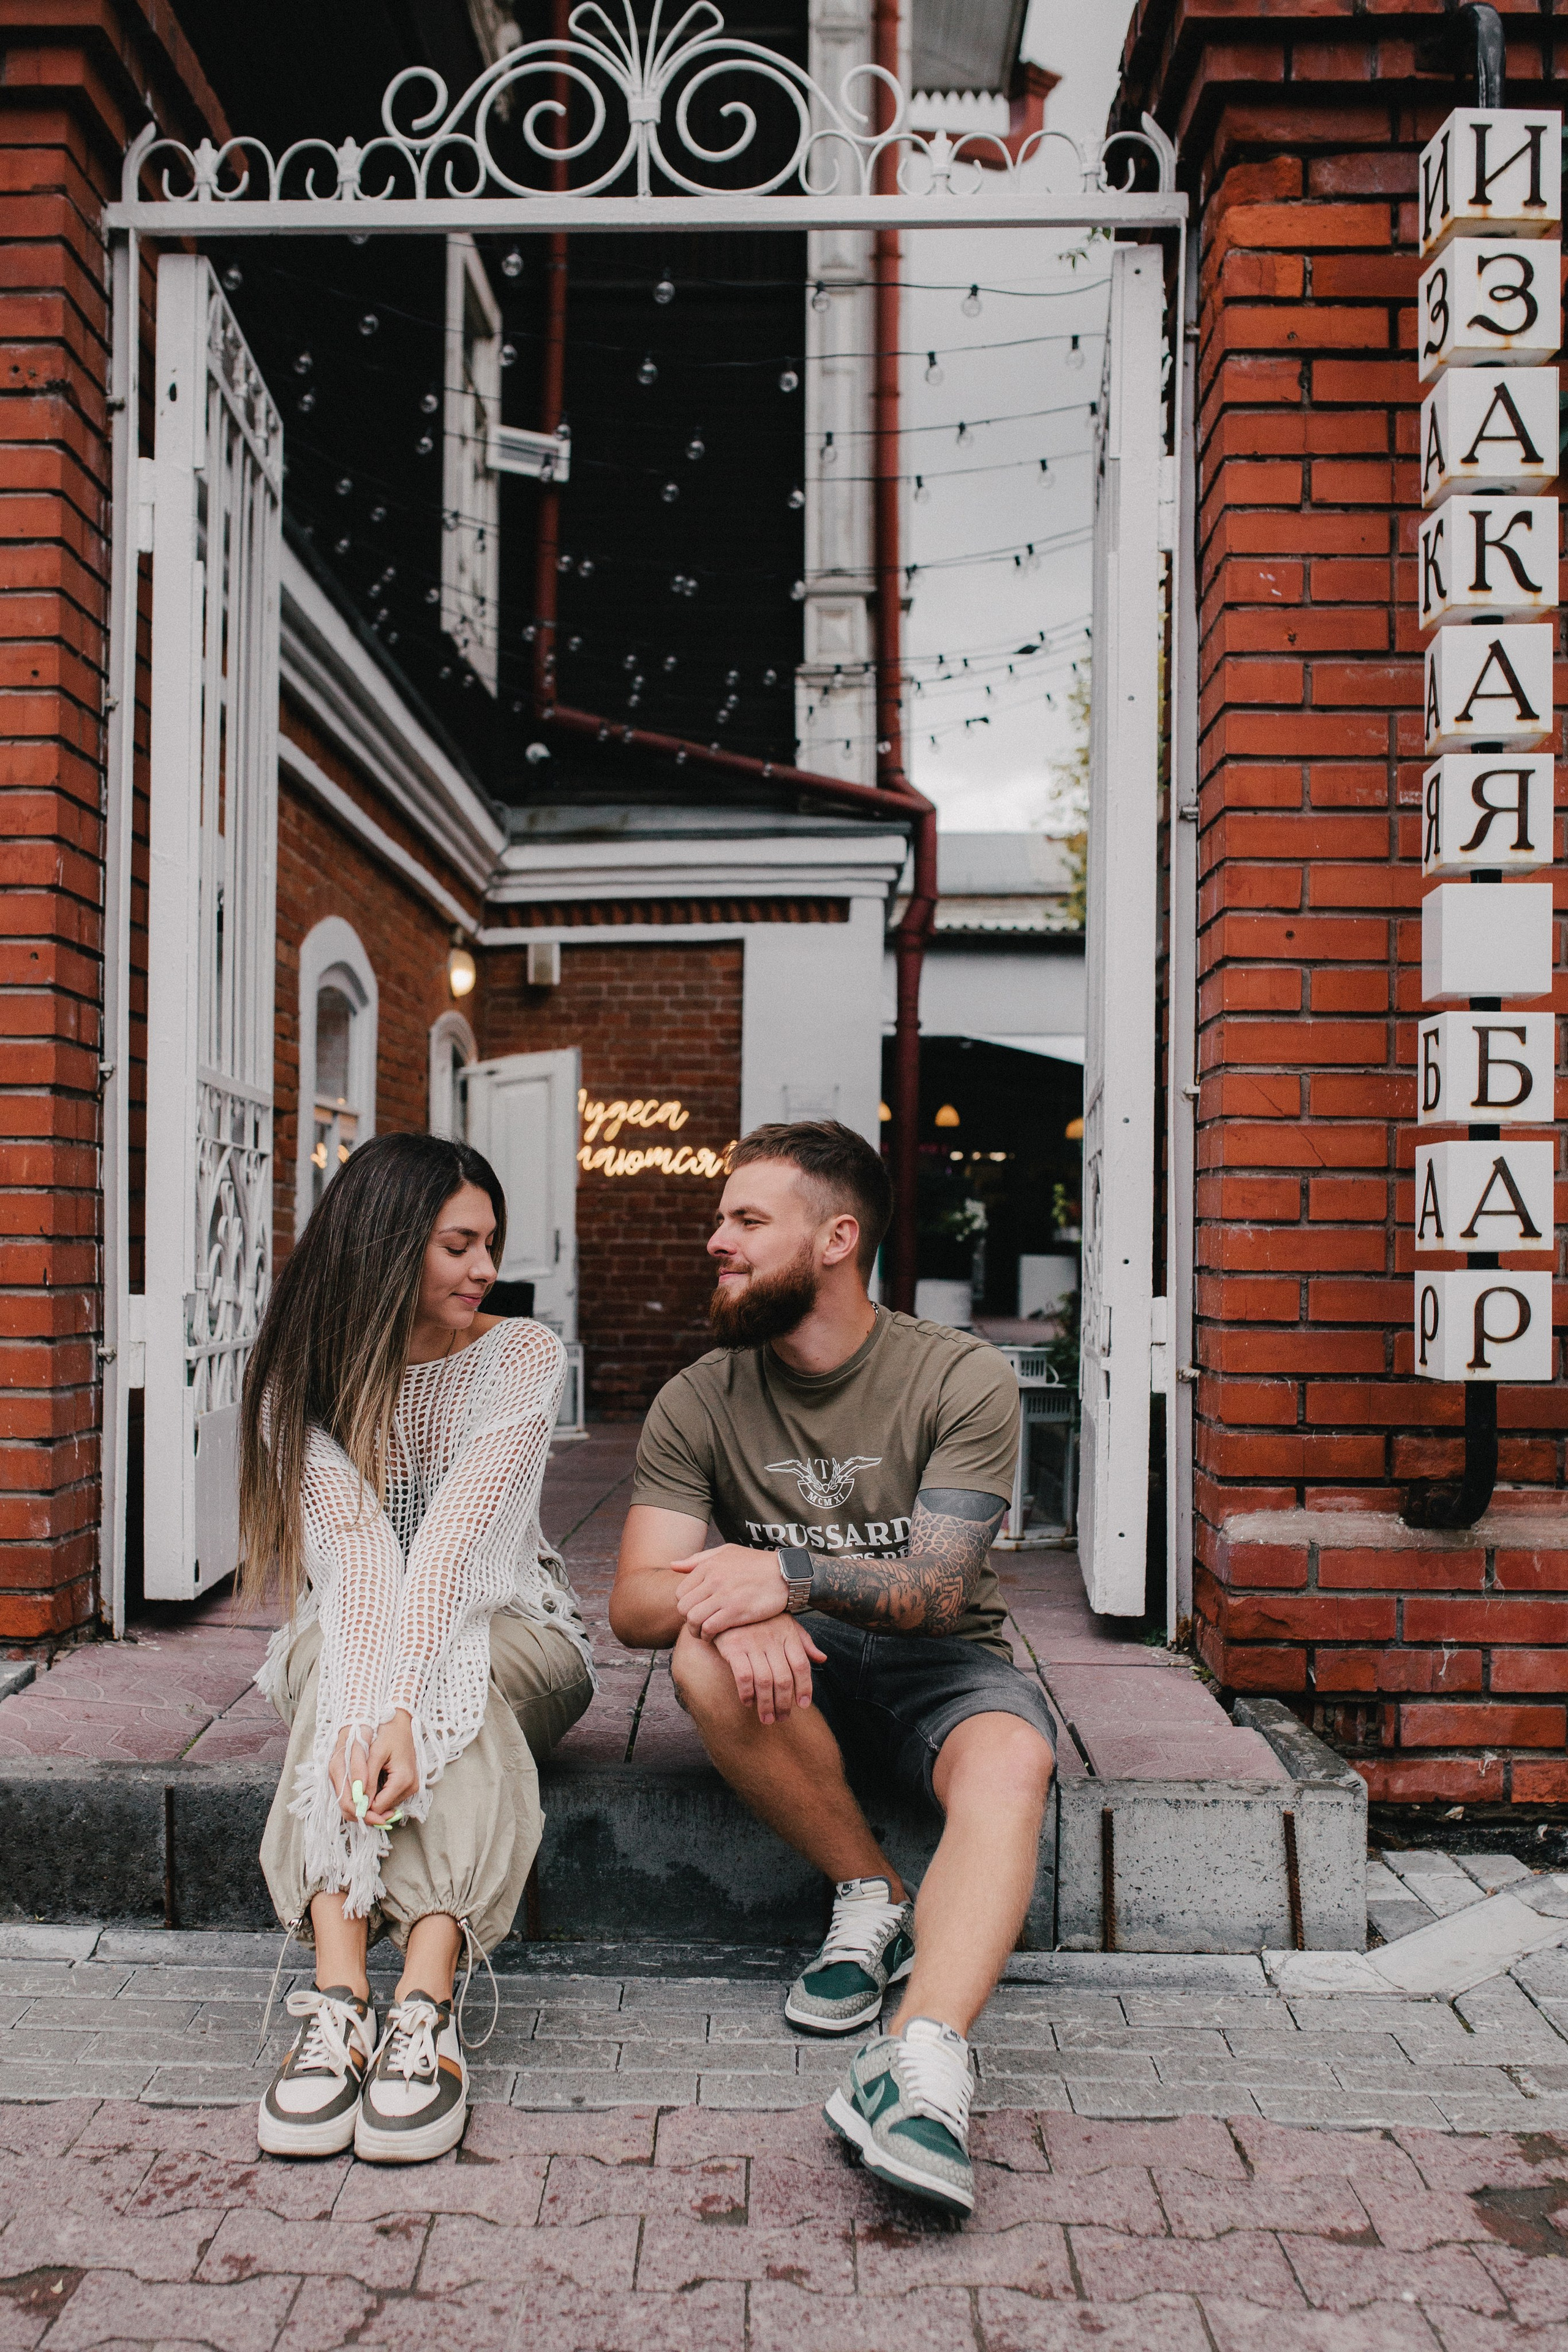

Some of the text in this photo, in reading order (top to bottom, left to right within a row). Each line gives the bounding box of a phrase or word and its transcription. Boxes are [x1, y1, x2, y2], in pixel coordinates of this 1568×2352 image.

[1455, 124, 1548, 1370] ИЗАКАЯ БАР
[745, 1517, 911, 1550] TRUSSARD
